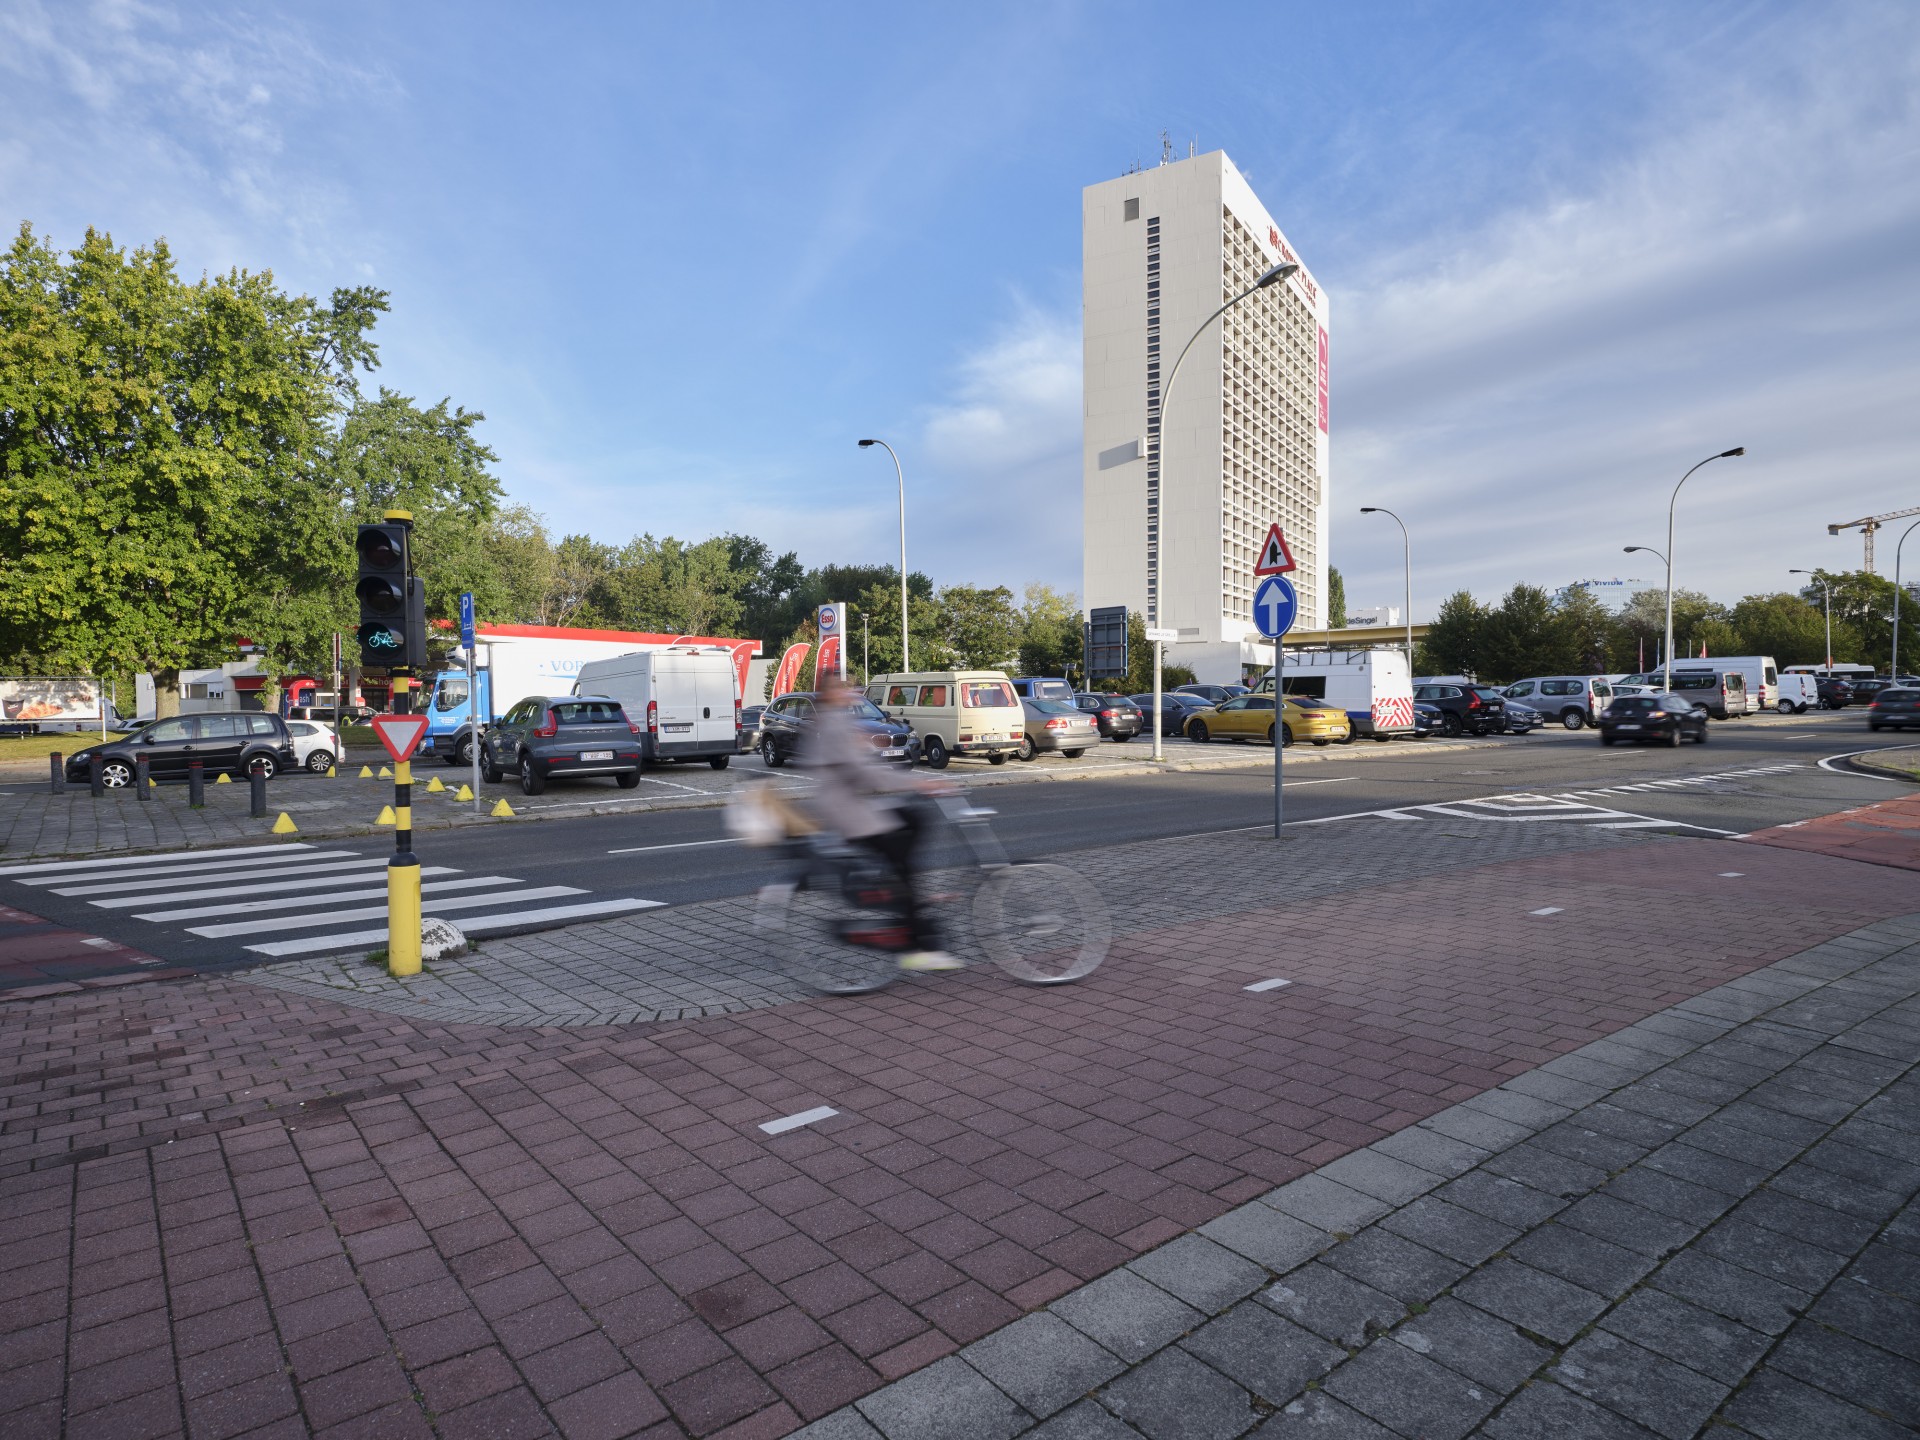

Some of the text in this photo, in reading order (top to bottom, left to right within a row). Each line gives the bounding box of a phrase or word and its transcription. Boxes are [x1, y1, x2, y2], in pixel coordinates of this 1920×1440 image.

[462, 596, 469, 619] P
[821, 614, 834, 624] Esso
[1346, 616, 1377, 625] deSingel
